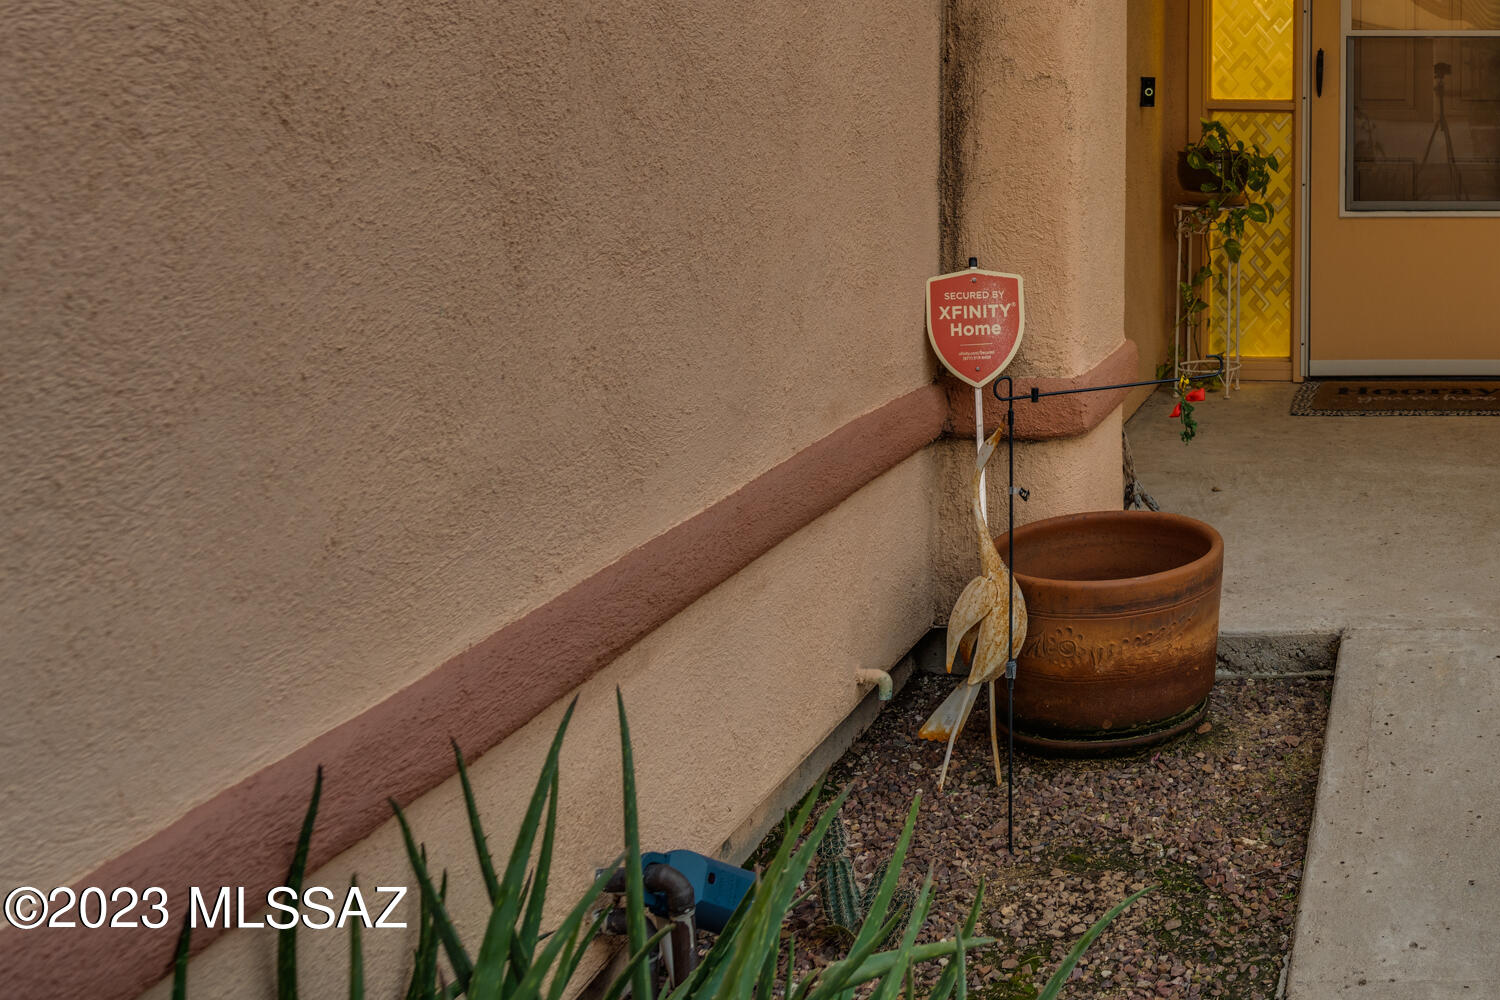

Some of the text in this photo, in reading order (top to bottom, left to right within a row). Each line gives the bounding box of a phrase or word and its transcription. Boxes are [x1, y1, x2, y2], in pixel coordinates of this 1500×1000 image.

[944, 290, 1005, 300] SECURED BY
[950, 323, 1002, 337] Home
